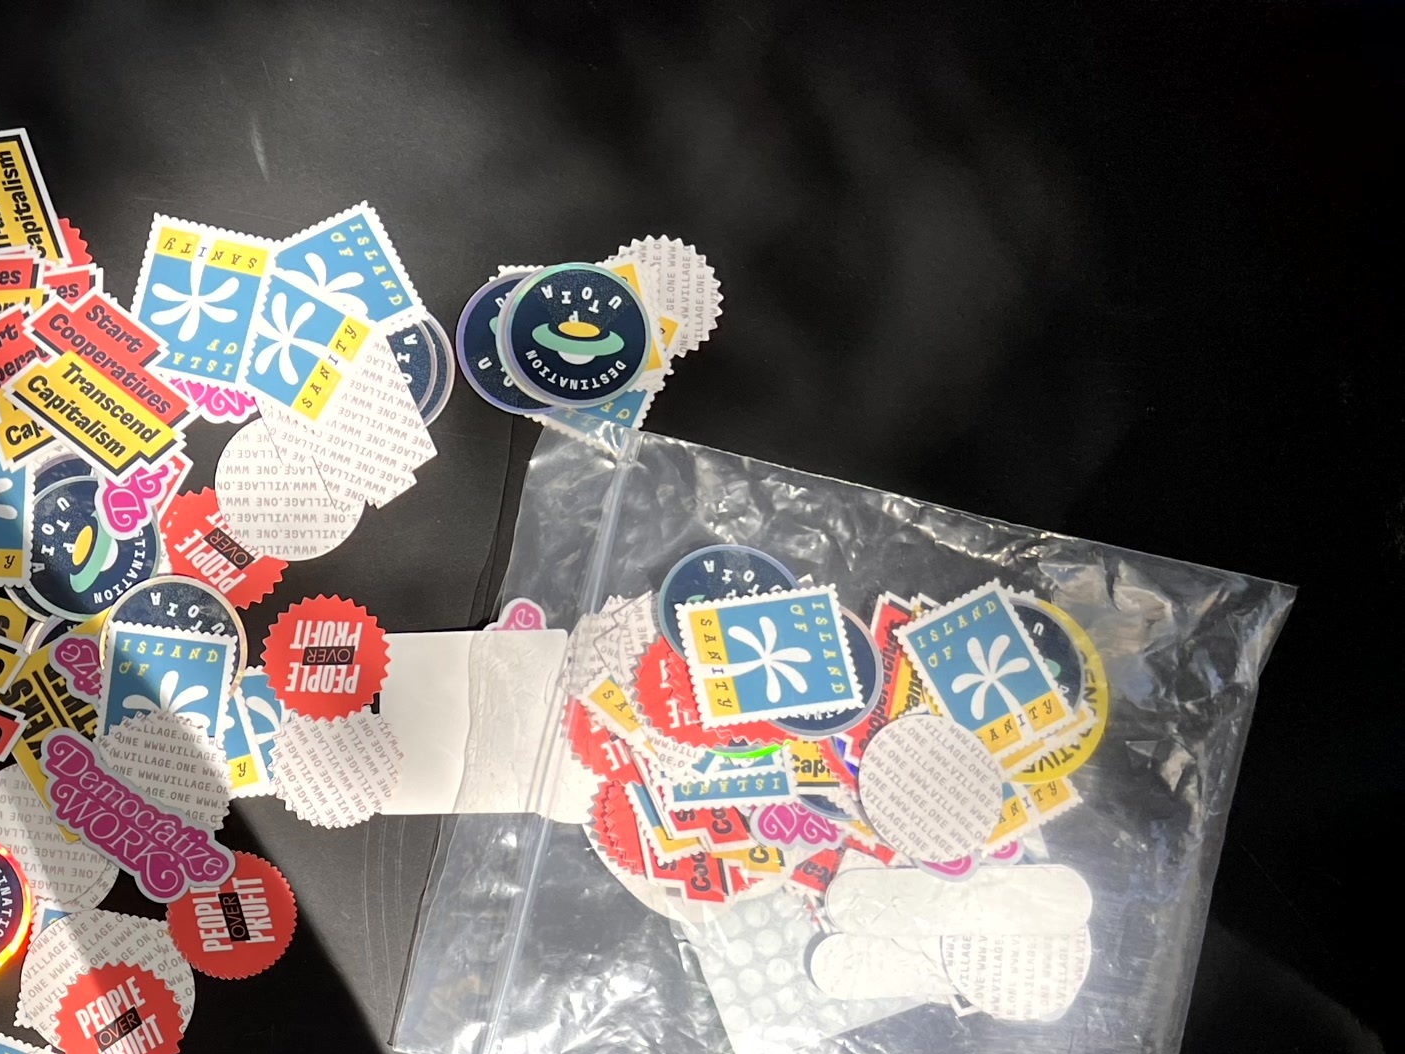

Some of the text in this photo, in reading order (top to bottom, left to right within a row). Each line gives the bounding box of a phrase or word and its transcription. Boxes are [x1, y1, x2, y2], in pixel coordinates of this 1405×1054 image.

[163, 238, 257, 268] SANITY
[330, 232, 354, 257] OF
[350, 223, 403, 306] ISLAND
[86, 304, 144, 354] Start
[49, 314, 171, 415] Cooperatives
[302, 324, 358, 408] SANITY
[525, 349, 627, 390] DESTINATION
[28, 375, 128, 458] Capitalism
[62, 362, 161, 443] Transcend
[209, 531, 249, 568] OVER
[290, 620, 363, 651] PROFIT
[812, 602, 845, 693] ISLAND
[917, 600, 997, 649] ISLAND
[119, 662, 149, 675] OF
[122, 640, 218, 663] ISLAND
[307, 648, 351, 662] OVER
[701, 618, 732, 708] SANITY
[285, 663, 360, 693] PEOPLE
[53, 741, 224, 878] Democratize
[55, 785, 179, 893] WORK
[223, 896, 245, 938] OVER
[232, 877, 275, 943] PROFIT
[74, 975, 146, 1039] PEOPLE
[96, 1011, 139, 1048] OVER
